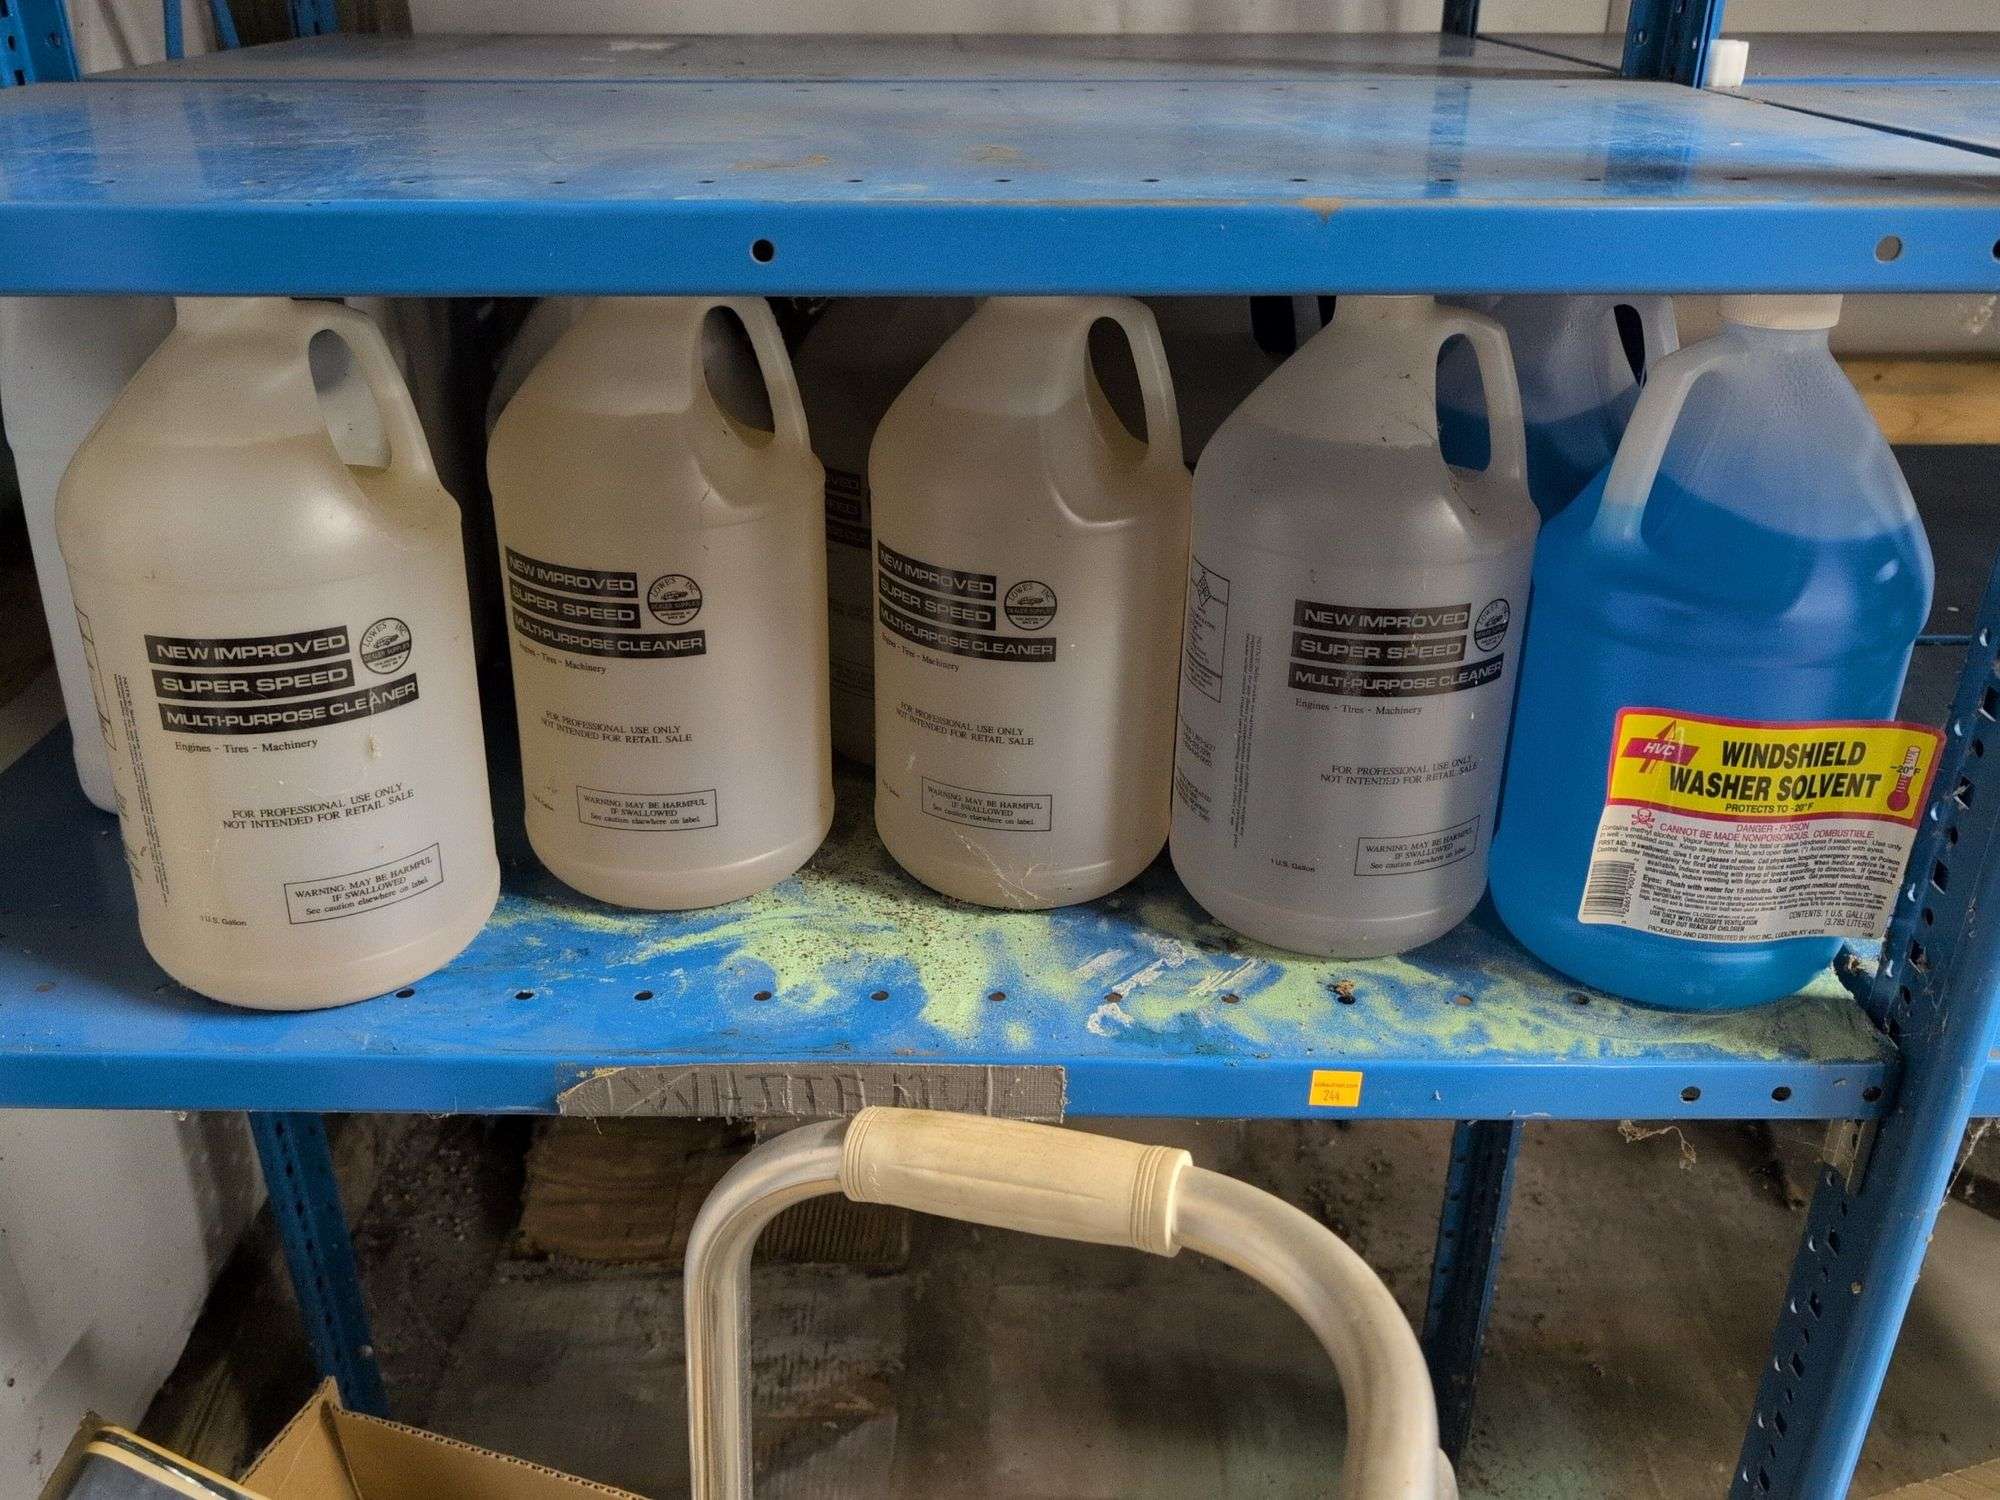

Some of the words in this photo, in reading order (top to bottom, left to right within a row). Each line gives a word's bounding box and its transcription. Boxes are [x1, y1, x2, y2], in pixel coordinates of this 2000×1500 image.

[508, 557, 535, 576] NEW
[537, 569, 635, 592] IMPROVED
[880, 551, 903, 570] NEW
[904, 565, 994, 594] IMPROVED
[511, 585, 558, 612] SUPER
[562, 603, 635, 621] SPEED
[880, 578, 921, 609] SUPER
[924, 602, 991, 623] SPEED
[1304, 608, 1353, 626] NEW
[1359, 611, 1468, 628] IMPROVED
[515, 615, 615, 650] MULTI-PURPOSE
[617, 638, 703, 652] CLEANER
[881, 608, 970, 649] MULTI-PURPOSE
[971, 639, 1053, 655] CLEANER
[156, 644, 209, 660] NEW
[214, 634, 347, 660] IMPROVED
[1300, 639, 1382, 659] SUPER
[1386, 642, 1462, 659] SPEED
[565, 659, 606, 674] Machinery
[921, 655, 960, 672] Machinery
[161, 677, 250, 693] SUPER
[256, 668, 348, 692] SPEED
[1295, 670, 1436, 690] MULTI-PURPOSE
[1439, 661, 1503, 687] CLEANER
[167, 707, 327, 727] MULTI-PURPOSE
[329, 682, 417, 715] CLEANER
[1295, 697, 1330, 711] Engines
[1341, 704, 1364, 714] Tires
[1375, 704, 1422, 716] Machinery
[561, 715, 626, 733] PROFESSIONAL
[630, 726, 649, 734] USE
[653, 725, 681, 734] ONLY
[910, 716, 947, 735] INTENDED
[950, 728, 967, 739] FOR
[971, 733, 1004, 744] RETAIL
[1009, 737, 1034, 746] SALE
[915, 707, 973, 731] PROFESSIONAL
[977, 725, 994, 734] USE
[997, 727, 1025, 736] ONLY
[556, 723, 600, 740] INTENDED
[602, 733, 622, 743] FOR
[625, 734, 662, 743] RETAIL
[665, 734, 692, 742] SALE
[175, 741, 211, 753] Engines
[223, 744, 249, 753] Tires
[262, 739, 318, 752] Machinery
[1643, 742, 1675, 755] HVC
[1722, 741, 1866, 769] WINDSHIELD
[1332, 765, 1352, 774] FOR
[1357, 765, 1427, 776] PROFESSIONAL
[1432, 761, 1449, 771] USE
[1452, 755, 1472, 767] ONLY
[1320, 774, 1342, 784] NOT
[1346, 775, 1400, 786] INTENDED
[1403, 774, 1422, 784] FOR
[1426, 769, 1455, 781] RETAIL
[1670, 766, 1772, 801] WASHER
[1777, 773, 1882, 801] SOLVENT
[223, 820, 247, 829] NOT
[251, 816, 313, 828] INTENDED
[318, 811, 341, 822] FOR
[346, 801, 385, 817] RETAIL
[389, 789, 415, 804] SALE
[232, 809, 255, 818] FOR
[260, 800, 346, 817] PROFESSIONAL
[350, 795, 371, 805] USE
[375, 783, 402, 798] ONLY
[625, 800, 645, 809] MAY
[648, 801, 660, 809] BE
[662, 799, 708, 808] HARMFUL
[961, 803, 1013, 817] SWALLOWED
[964, 795, 983, 805] MAY
[987, 799, 998, 808] BE
[1000, 801, 1042, 810] HARMFUL
[1725, 804, 1774, 813] PROTECTS
[1777, 804, 1788, 813] TO
[621, 808, 677, 817] SWALLOWED
[1660, 823, 1697, 836] CANNOT
[1700, 830, 1712, 839] BE
[1713, 832, 1740, 841] MADE
[1737, 824, 1773, 832] DANGER
[1780, 822, 1809, 831] POISON
[350, 878, 371, 890] MAY
[376, 874, 388, 882] BE
[391, 857, 432, 877] HARMFUL
[1370, 861, 1383, 870] See
[332, 894, 343, 902] IF
[345, 877, 407, 900] SWALLOWED
[1666, 879, 1686, 888] Flush
[1687, 882, 1702, 890] with
[1789, 884, 1812, 892] prompt
[1812, 881, 1837, 889] medical
[325, 901, 355, 912] caution
[357, 890, 396, 905] elsewhere
[1660, 918, 1675, 926] KEEP
[1689, 922, 1708, 931] REACH
[1662, 912, 1676, 920] ONLY
[1846, 911, 1875, 920] GALLON
[1846, 920, 1875, 929] LITERS)
[1648, 924, 1682, 937] PACKAGED
[1697, 932, 1738, 940] DISTRIBUTED
